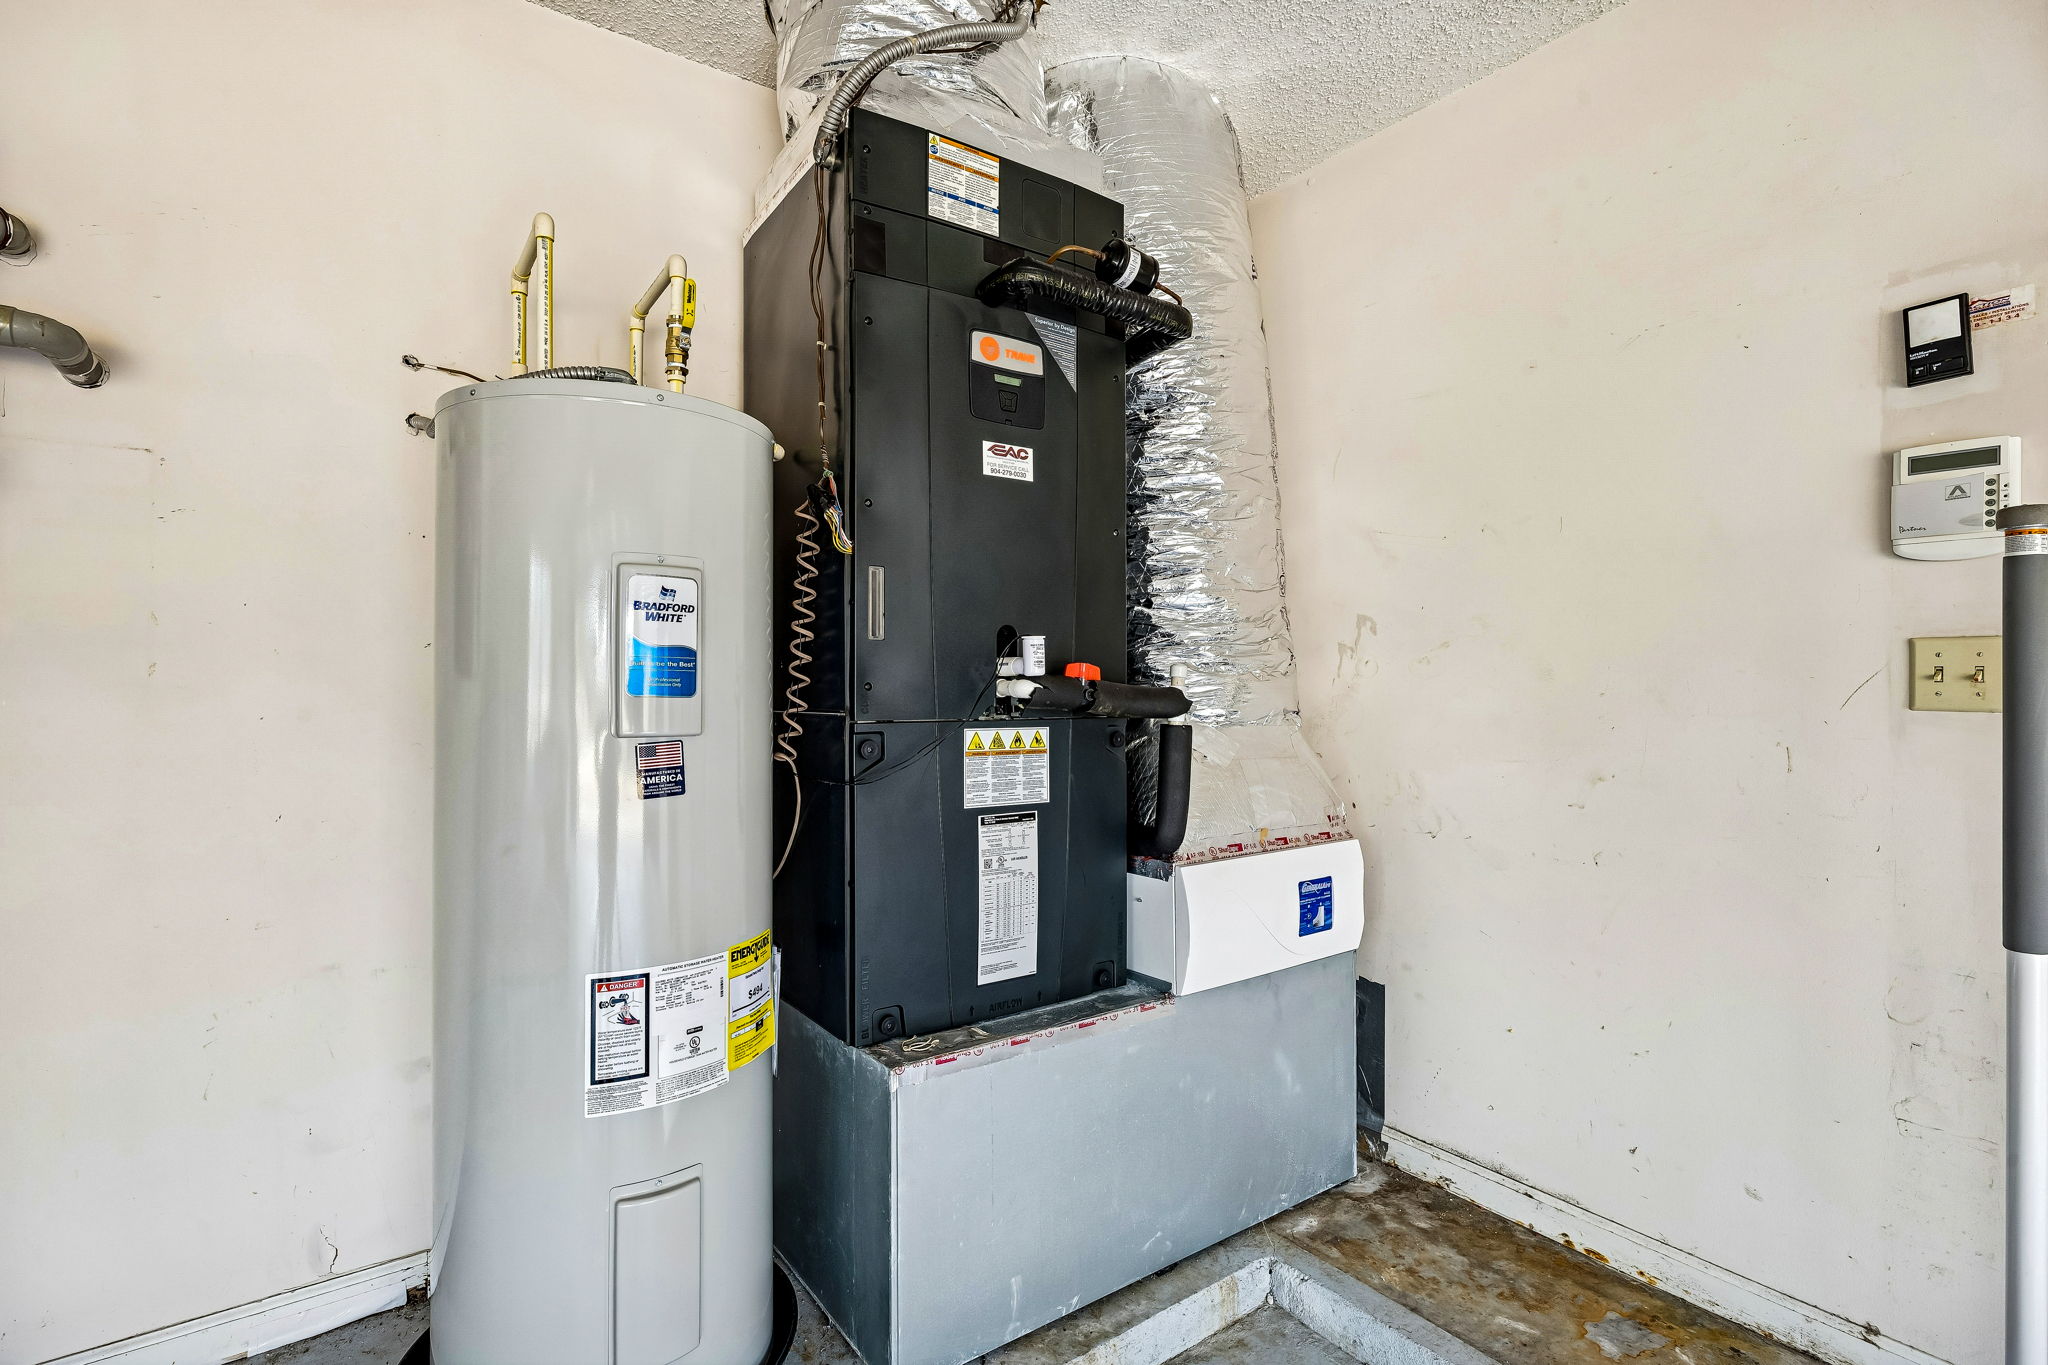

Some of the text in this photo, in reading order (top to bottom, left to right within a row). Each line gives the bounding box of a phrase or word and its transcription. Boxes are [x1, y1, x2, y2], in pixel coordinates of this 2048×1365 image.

[1005, 349, 1036, 364] TRANE
[998, 463, 1018, 471] SERVICE
[990, 468, 1027, 479] 904-279-0030
[633, 600, 695, 613] BRADFORD
[644, 611, 684, 623] WHITE
[640, 774, 683, 785] AMERICA
[662, 964, 684, 972] AUTOMATIC
[610, 981, 638, 990] DANGER
[748, 983, 763, 1000] $494
[989, 996, 1023, 1012] AIRFLOW
